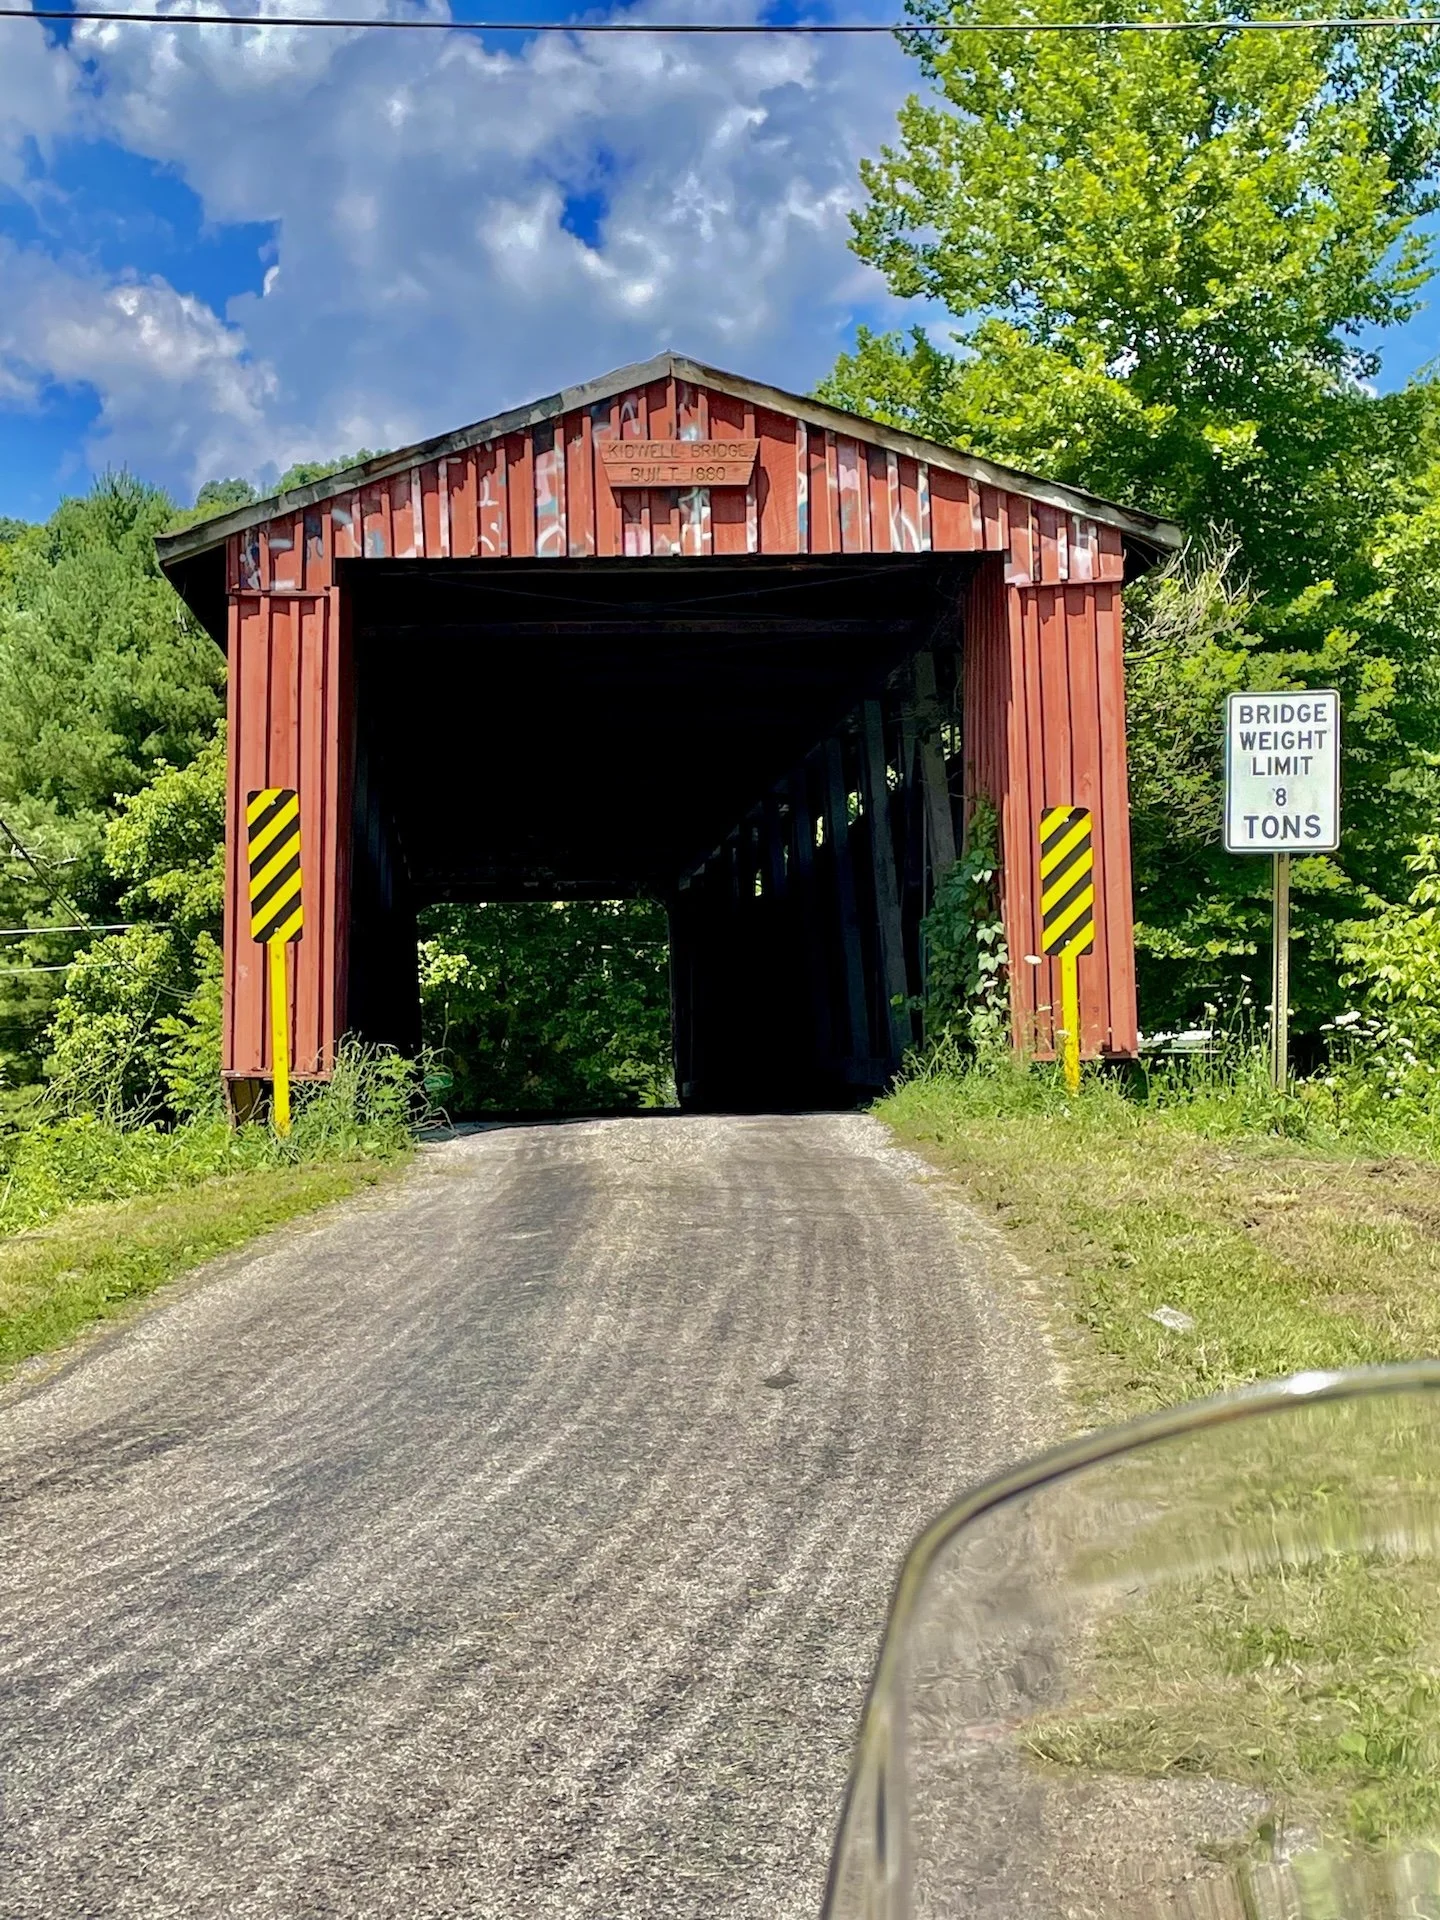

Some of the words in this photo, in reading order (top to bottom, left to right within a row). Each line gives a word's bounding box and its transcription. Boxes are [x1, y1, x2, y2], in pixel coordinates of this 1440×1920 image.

[608, 443, 680, 459] KIDWELL
[691, 443, 750, 458] BRIDGE
[631, 467, 680, 482] BUILT
[1239, 703, 1327, 724] BRIDGE
[1239, 730, 1328, 751] WEIGHT
[1252, 756, 1313, 776] LIMIT
[1275, 787, 1287, 807] 8
[1243, 814, 1321, 839] TONS
